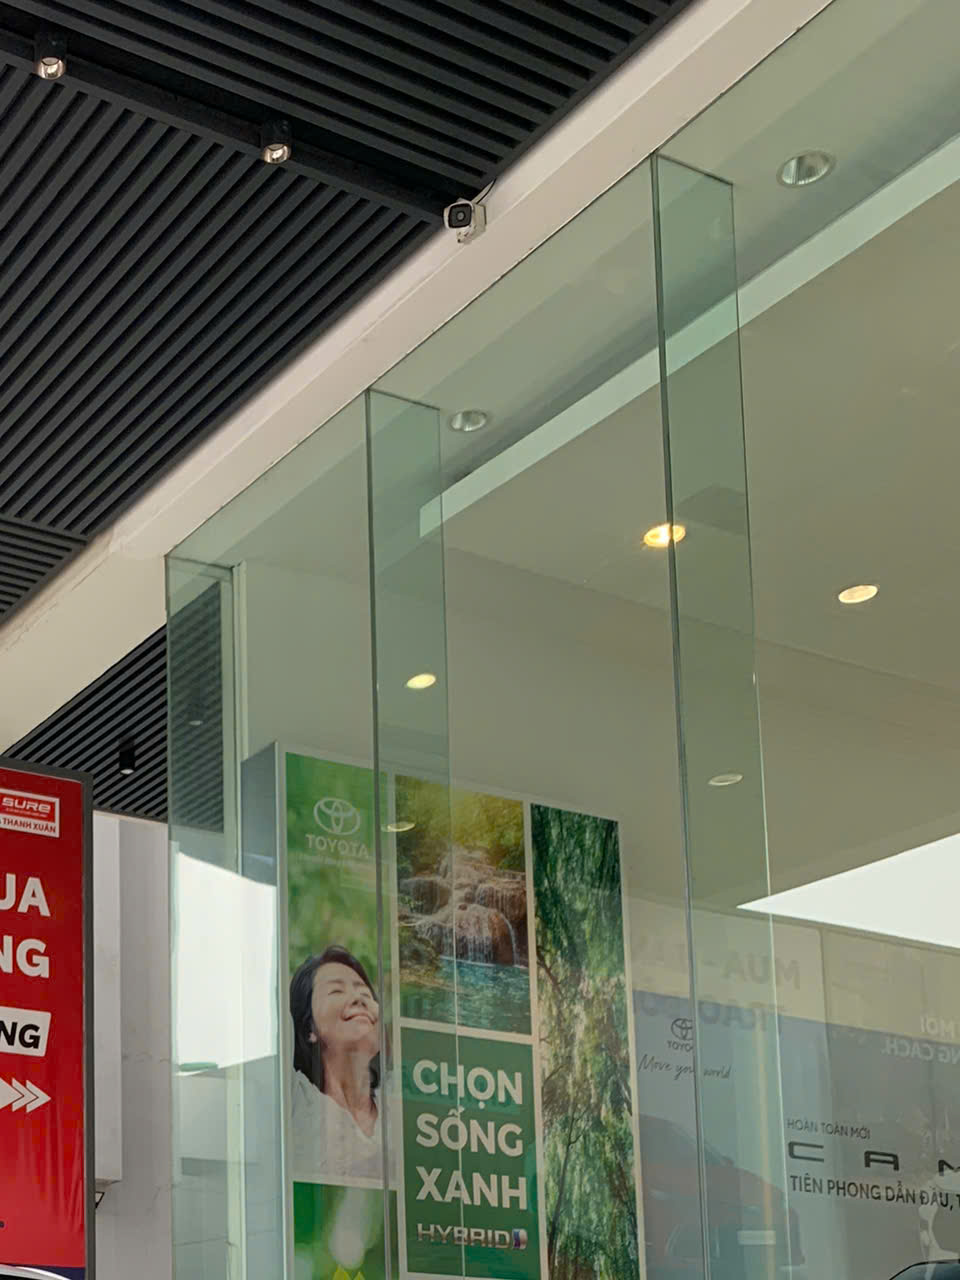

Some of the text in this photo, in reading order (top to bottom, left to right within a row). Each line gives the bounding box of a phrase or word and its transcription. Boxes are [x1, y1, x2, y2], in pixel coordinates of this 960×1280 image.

[2, 817, 32, 829] THANH
[305, 833, 369, 859] TOYOTA
[637, 1053, 672, 1072] Move
[412, 1059, 523, 1109] CHỌN
[415, 1104, 524, 1157] SỐNG
[415, 1165, 527, 1210] XANH
[790, 1172, 823, 1194] TIÊN
[827, 1179, 881, 1201] PHONG
[417, 1223, 510, 1249] HYBRID
